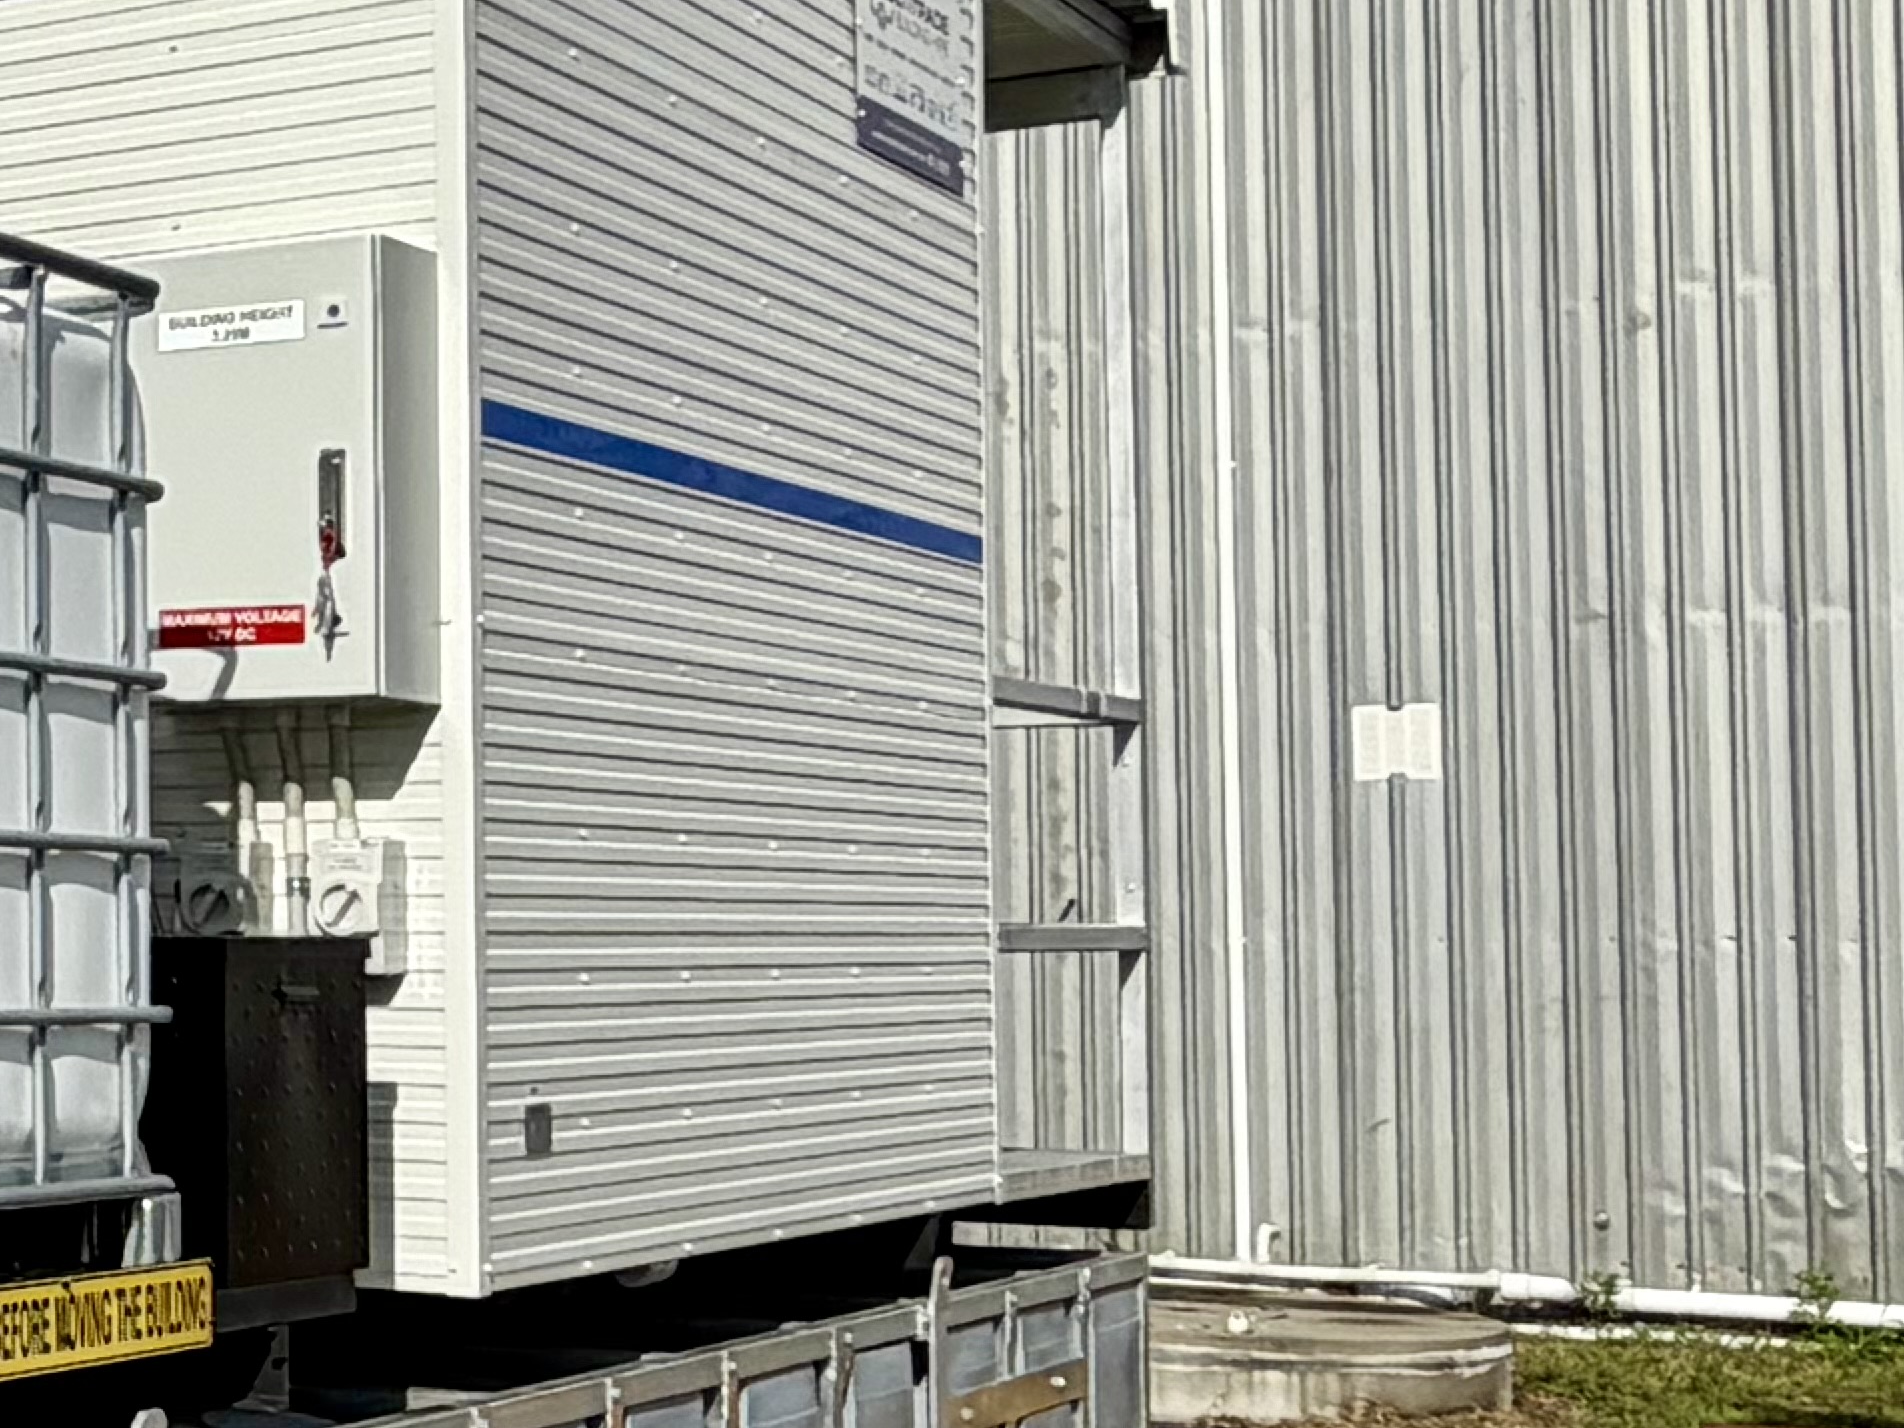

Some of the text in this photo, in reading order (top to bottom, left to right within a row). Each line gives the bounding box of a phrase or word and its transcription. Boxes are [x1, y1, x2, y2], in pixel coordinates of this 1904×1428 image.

[54, 1288, 112, 1352] MOVING
[116, 1285, 142, 1342] THE
[146, 1276, 206, 1338] BUILDING
